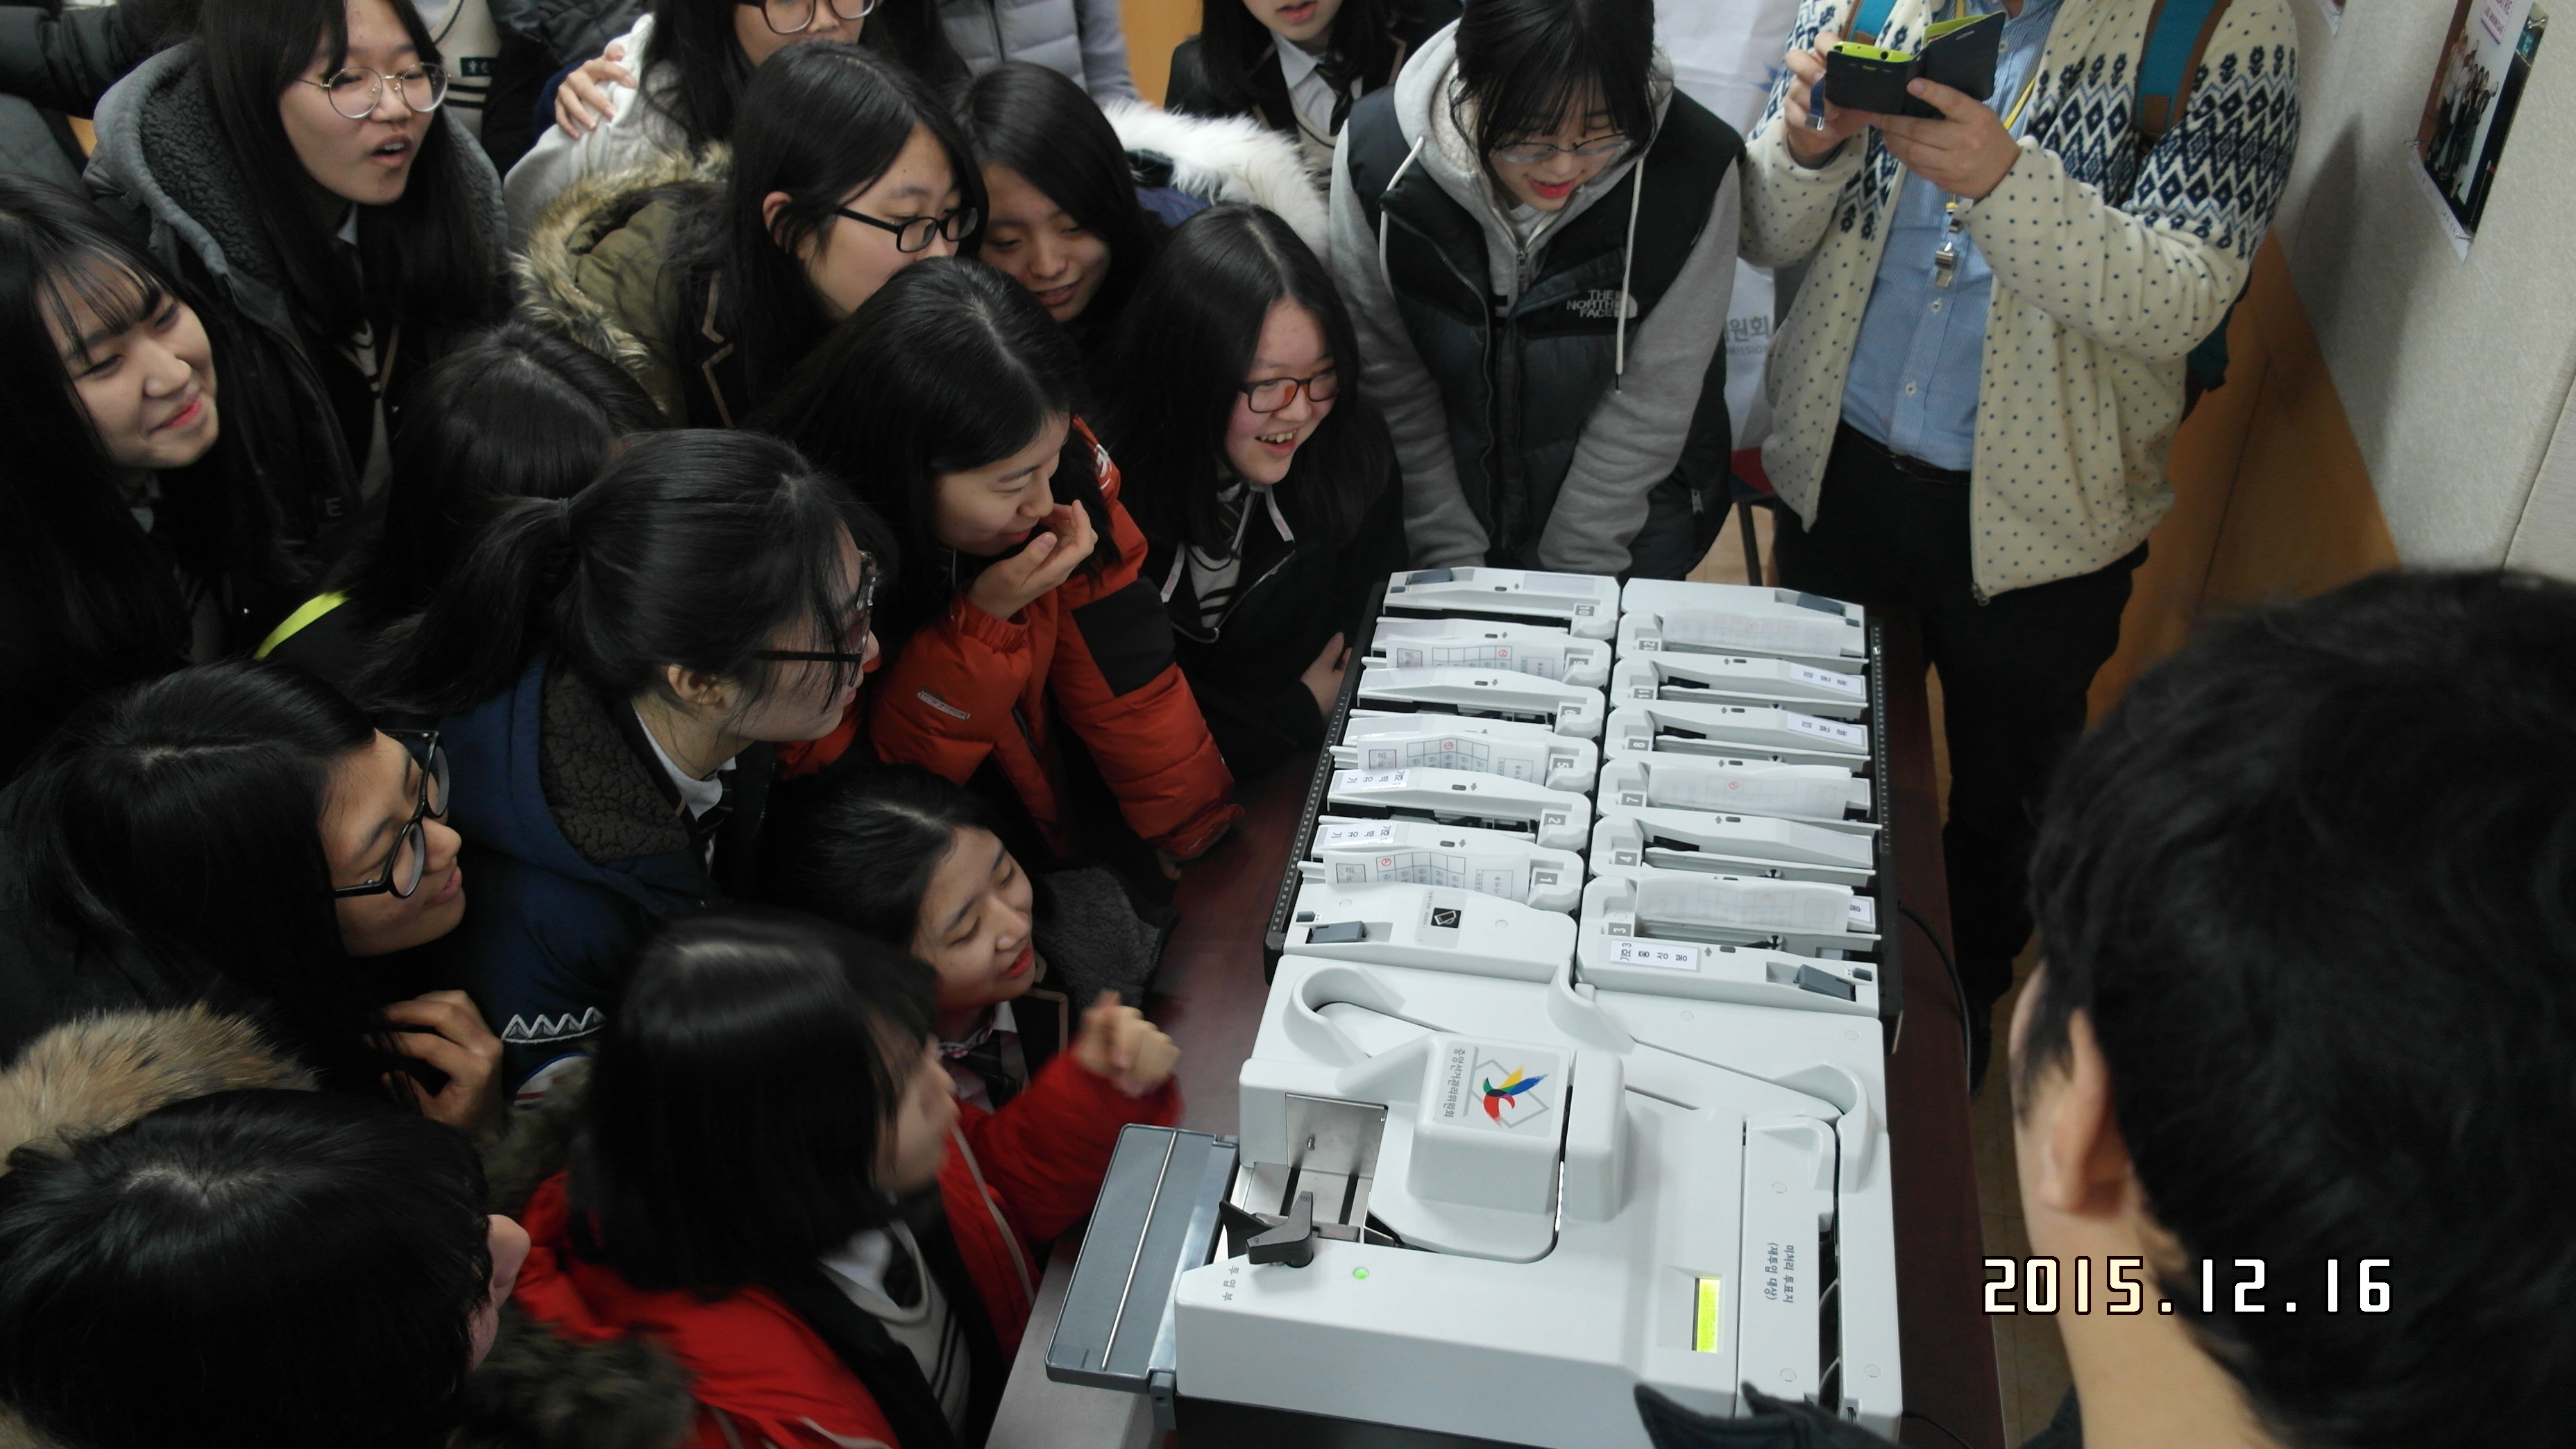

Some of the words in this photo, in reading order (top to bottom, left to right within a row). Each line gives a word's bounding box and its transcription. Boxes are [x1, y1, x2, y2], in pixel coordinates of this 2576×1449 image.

[1566, 299, 1613, 311] NORTH
[1587, 289, 1615, 300] THE
[1579, 309, 1613, 319] FACE
[1726, 316, 1770, 342] 원회
[1578, 605, 1590, 616] 10
[1643, 641, 1656, 651] 12
[1638, 689, 1650, 698] 11
[1443, 1048, 1466, 1119] 중앙선거관리위원회
[1765, 1242, 1779, 1274] (재투입
[1783, 1244, 1795, 1271] 미처리
[1222, 1265, 1240, 1303] 투입부
[1764, 1277, 1778, 1301] 대상)
[1782, 1273, 1795, 1304] 투표지
